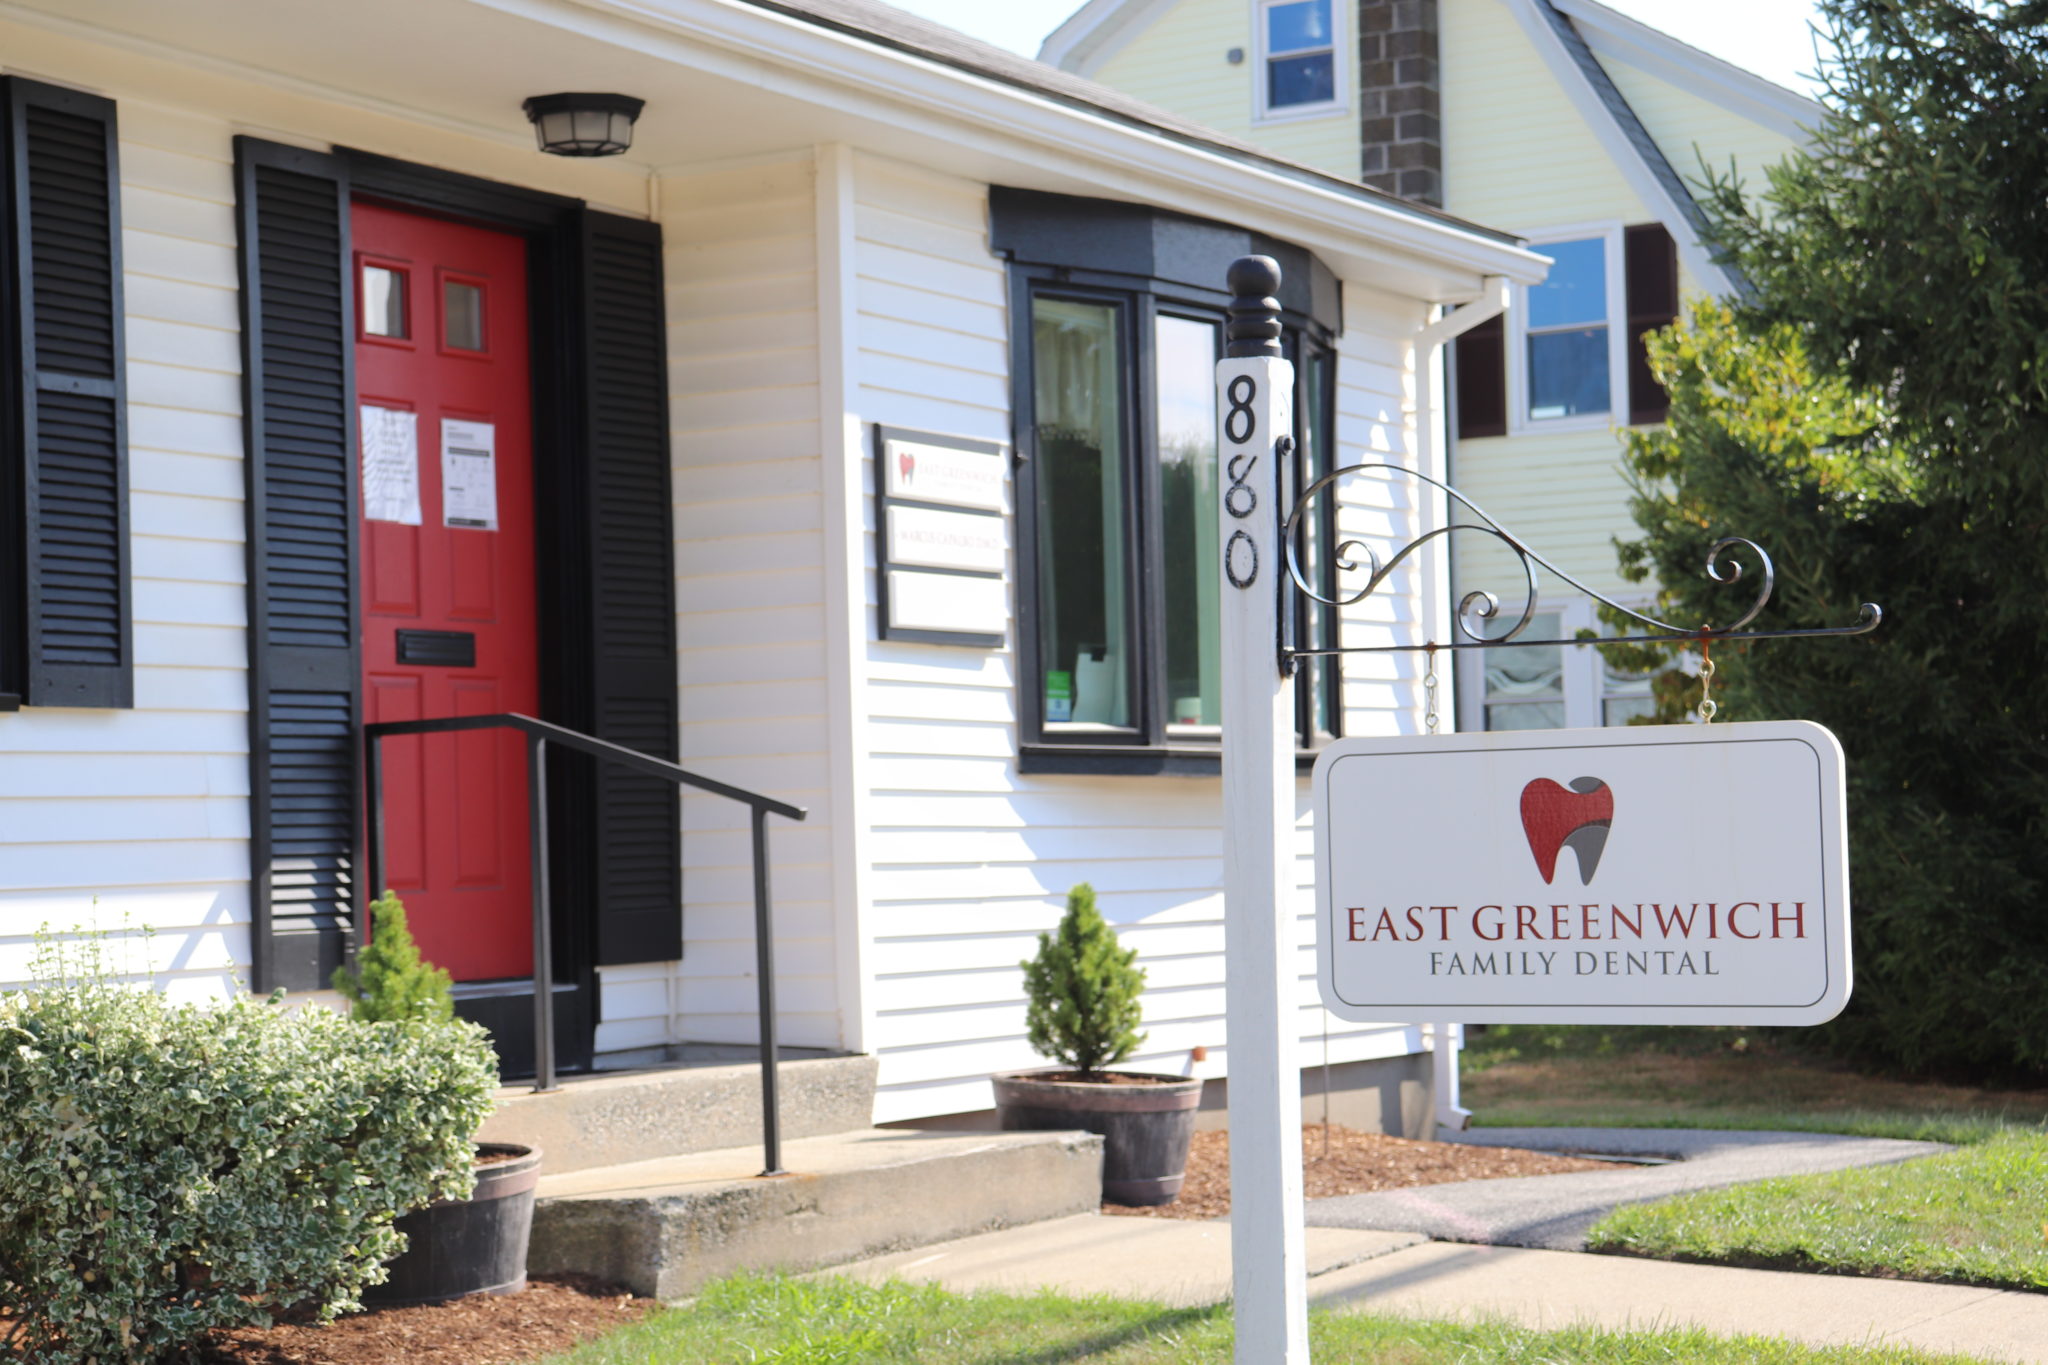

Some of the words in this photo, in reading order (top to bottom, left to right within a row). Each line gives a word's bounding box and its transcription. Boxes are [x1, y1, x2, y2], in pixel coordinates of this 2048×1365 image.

[1346, 904, 1458, 943] EAST
[1471, 901, 1808, 941] GREENWICH
[1429, 950, 1557, 976] FAMILY
[1574, 950, 1720, 976] DENTAL
